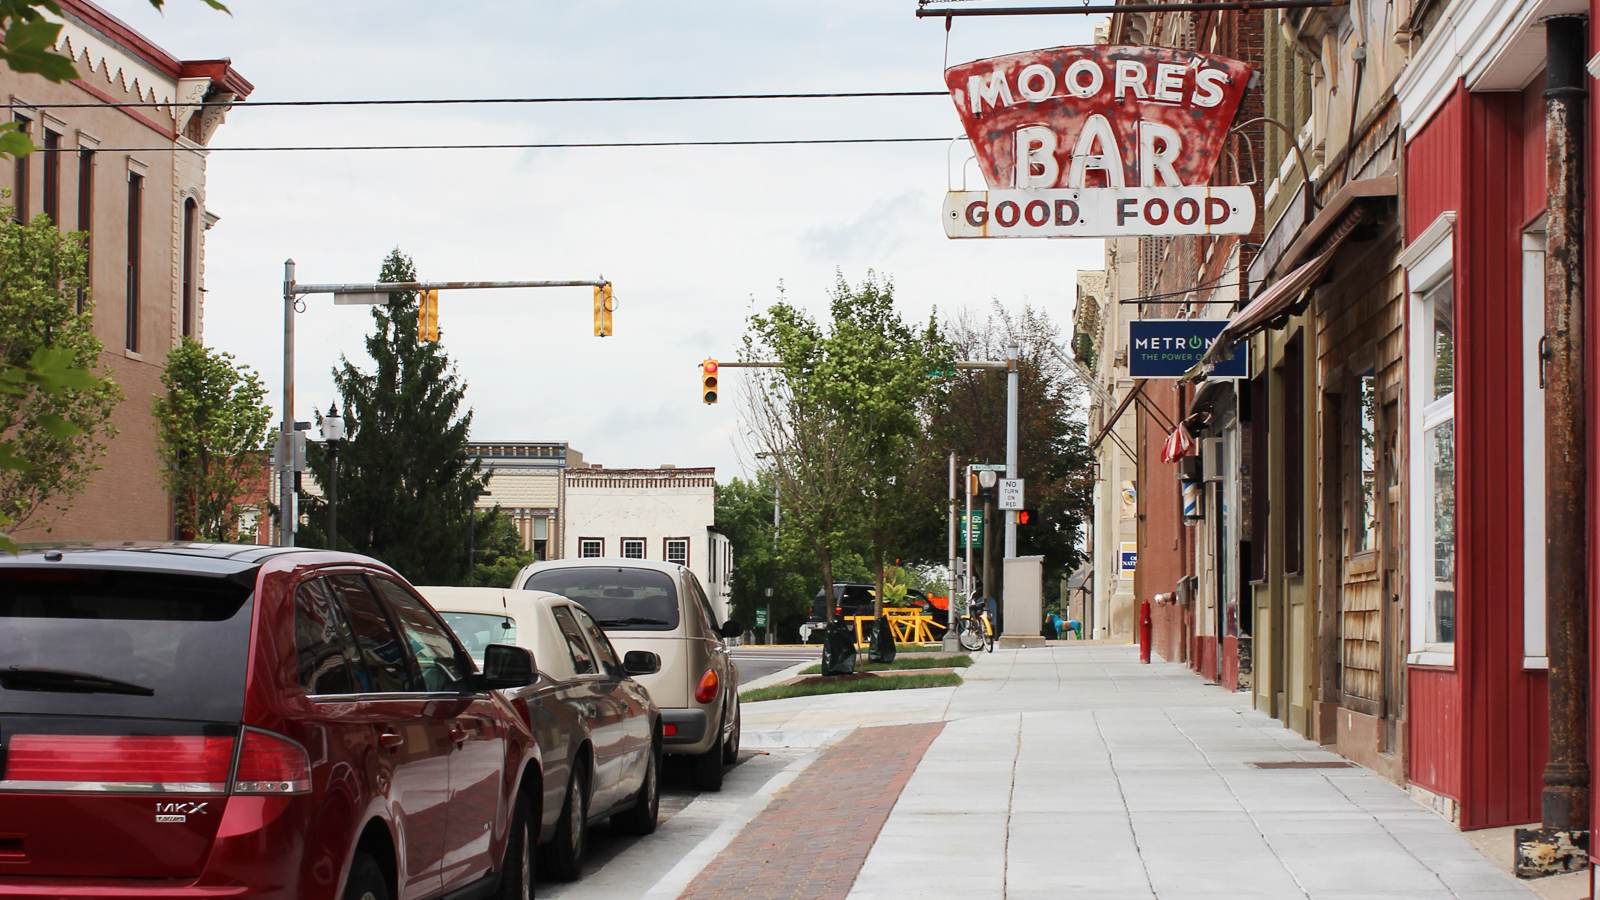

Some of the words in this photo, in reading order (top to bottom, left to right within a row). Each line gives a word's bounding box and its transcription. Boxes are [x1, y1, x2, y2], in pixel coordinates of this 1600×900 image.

[968, 55, 1229, 114] MOORE'S
[1015, 113, 1184, 189] BAR
[965, 199, 1080, 227] GOOD
[1116, 197, 1231, 226] FOOD
[1141, 353, 1159, 361] THE
[1161, 353, 1193, 361] POWER
[156, 801, 209, 815] MKX
